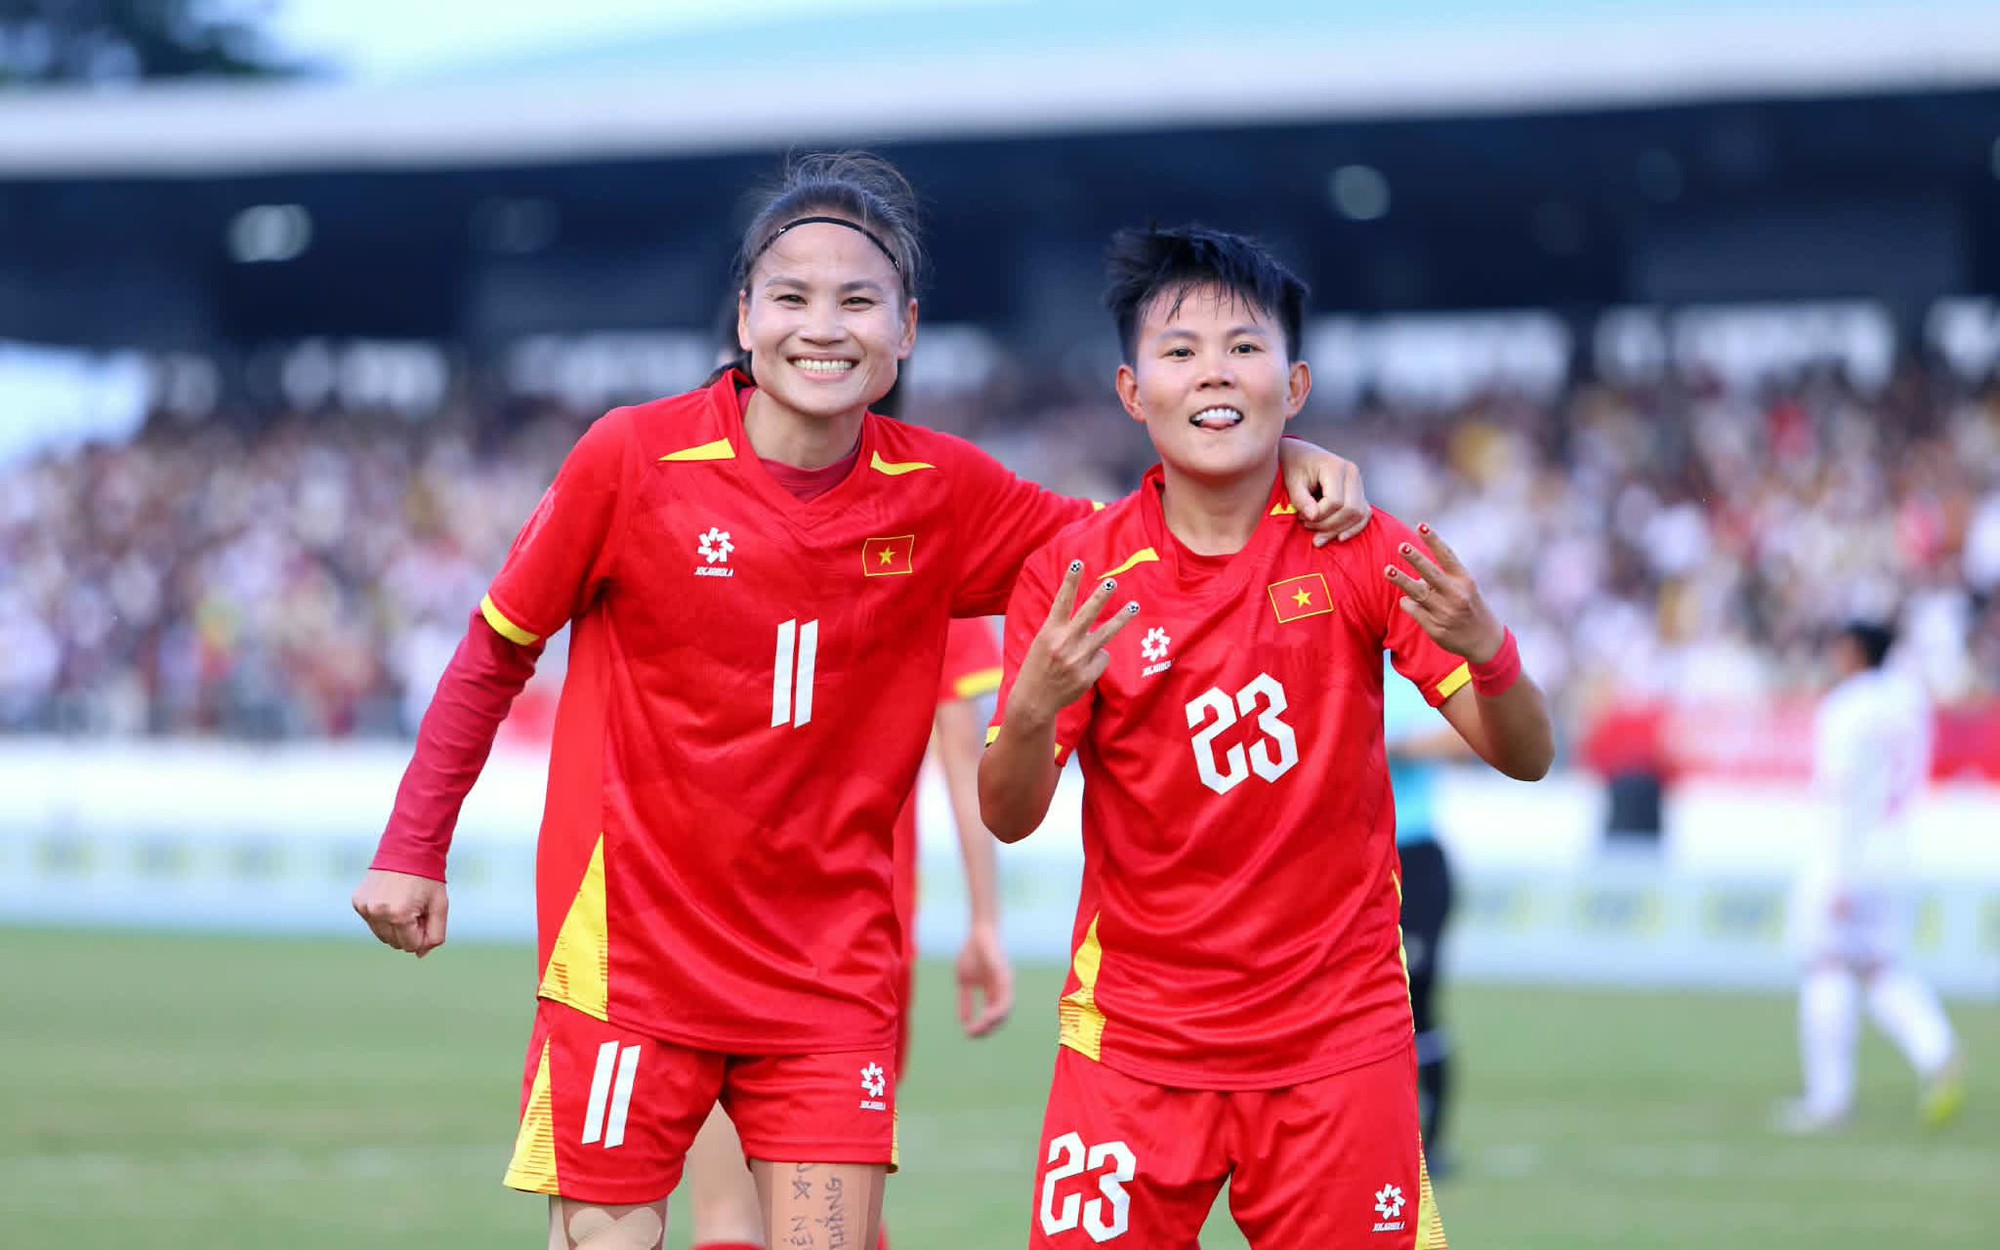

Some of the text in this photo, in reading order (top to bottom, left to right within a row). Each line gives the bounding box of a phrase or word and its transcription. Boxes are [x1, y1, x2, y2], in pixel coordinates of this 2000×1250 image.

[771, 618, 819, 729] 11
[1185, 672, 1299, 796] 23
[581, 1040, 642, 1149] 11
[1039, 1131, 1137, 1243] 23
